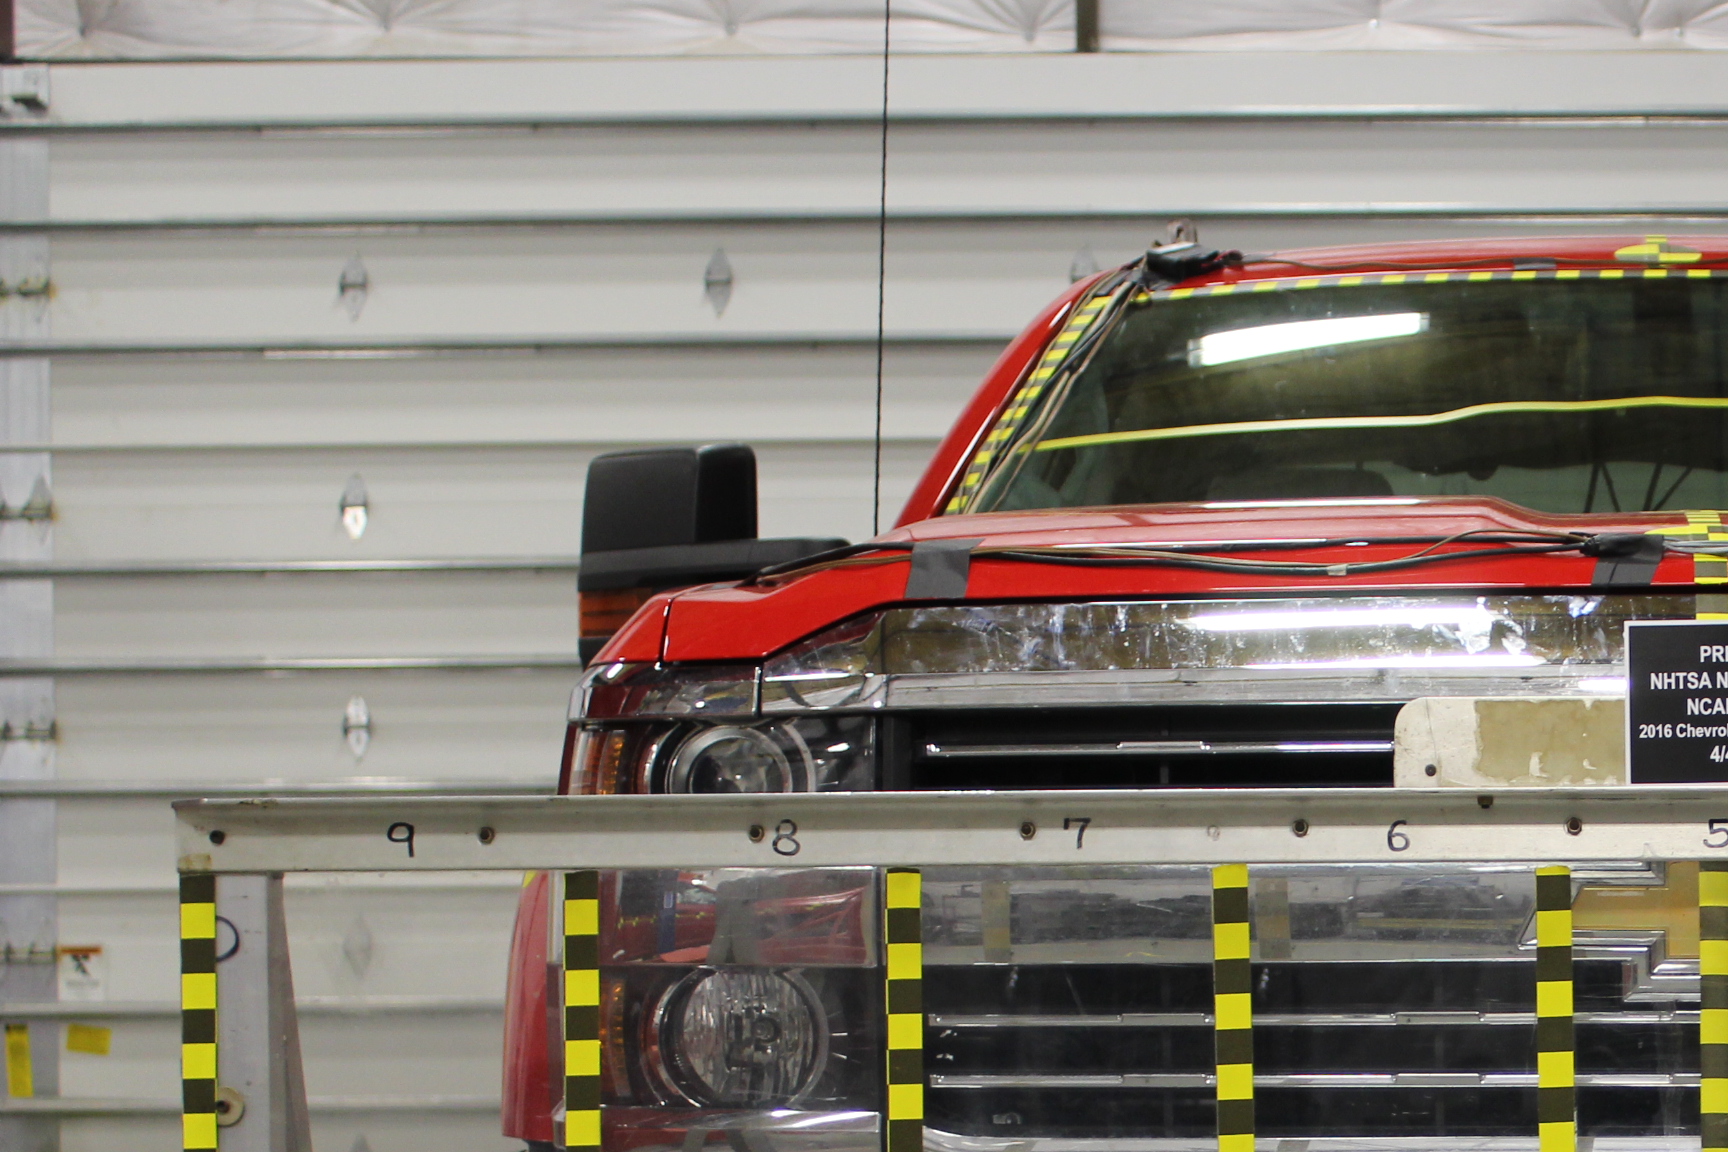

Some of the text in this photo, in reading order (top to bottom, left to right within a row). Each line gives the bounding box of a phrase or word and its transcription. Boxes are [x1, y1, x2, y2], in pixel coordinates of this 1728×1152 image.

[1650, 671, 1712, 690] NHTSA
[1639, 724, 1673, 739] 2016
[386, 821, 416, 858] 9
[771, 818, 801, 857] 8
[1062, 813, 1093, 850] 7
[1386, 818, 1411, 853] 6
